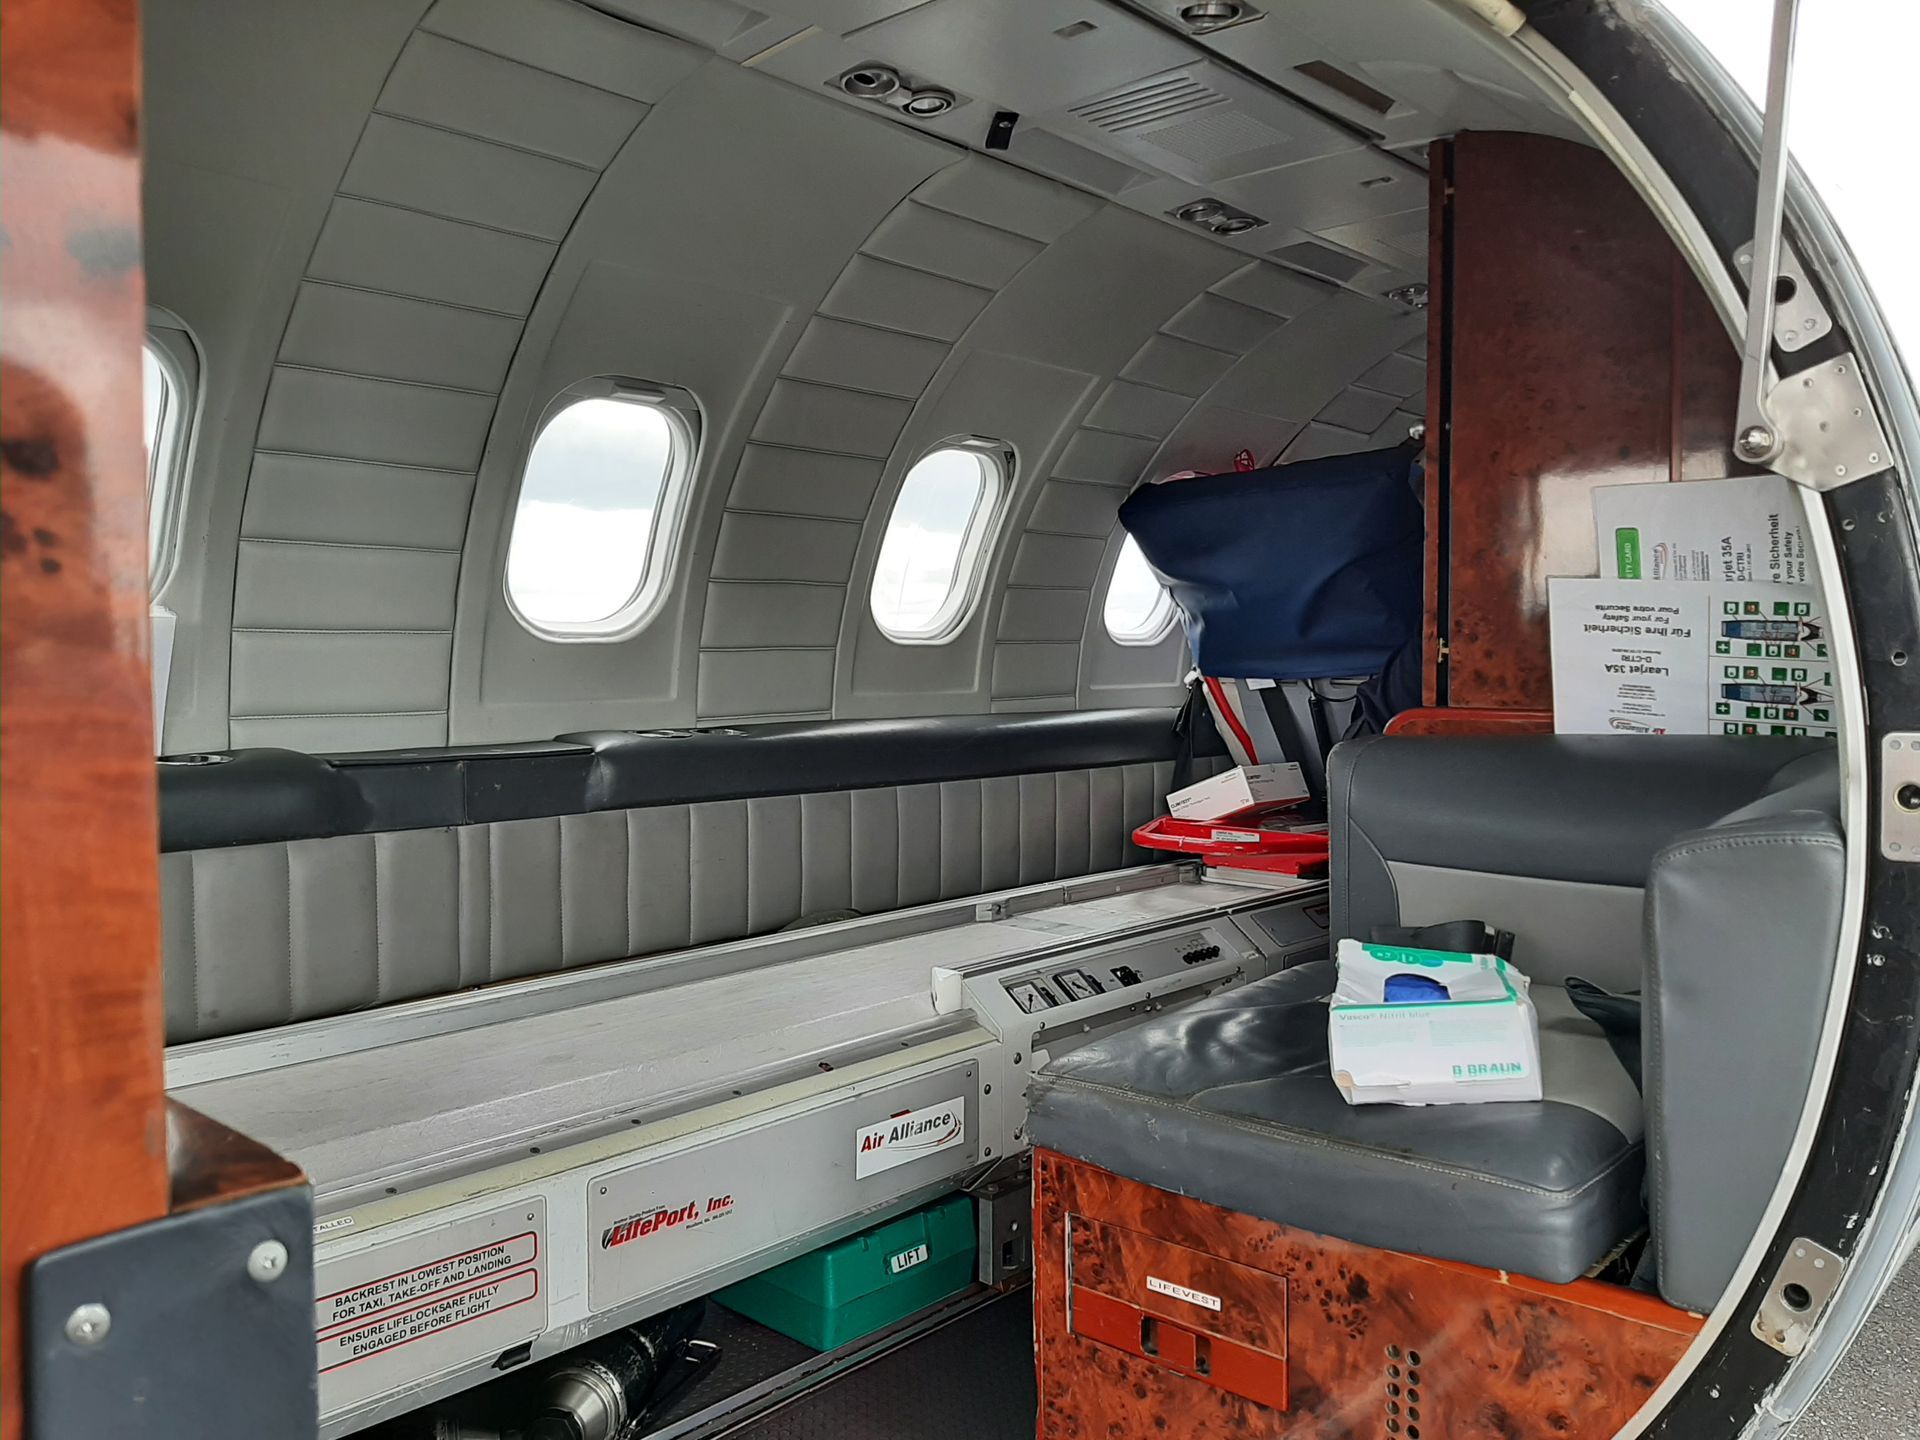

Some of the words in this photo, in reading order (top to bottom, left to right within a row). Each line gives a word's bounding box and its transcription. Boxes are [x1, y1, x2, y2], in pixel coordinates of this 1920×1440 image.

[1721, 536, 1732, 557] 35A
[1768, 513, 1780, 570] Sicherheit
[1784, 531, 1794, 558] Safety
[1786, 560, 1795, 579] your
[1602, 613, 1630, 622] Safety
[1657, 607, 1680, 615] Pour
[1583, 623, 1642, 635] Sicherheit
[1654, 617, 1670, 625] For
[1645, 627, 1668, 637] Ihre
[1670, 628, 1691, 638] Für
[1604, 664, 1626, 674] 35A
[1629, 664, 1669, 677] Learjet
[1467, 1061, 1522, 1074] BRAUN
[861, 1132, 885, 1152] Air
[888, 1113, 951, 1144] Alliance
[706, 1195, 734, 1213] Inc.
[896, 1247, 920, 1269] LIFT
[335, 1281, 395, 1308] BACKREST
[397, 1277, 409, 1288] IN
[411, 1262, 457, 1283] LOWEST
[458, 1245, 505, 1267] POSITION
[332, 1306, 356, 1322] FOR
[358, 1297, 386, 1315] TAXI,
[388, 1279, 441, 1303] TAKE-OFF
[443, 1271, 466, 1285] AND
[467, 1255, 512, 1277] LANDING
[1149, 1279, 1218, 1307] LIFEVEST
[340, 1324, 386, 1347] ENSURE
[468, 1284, 500, 1304] FULLY
[353, 1328, 407, 1356] ENGAGED
[409, 1313, 452, 1336] BEFORE
[454, 1300, 492, 1321] FLIGHT
